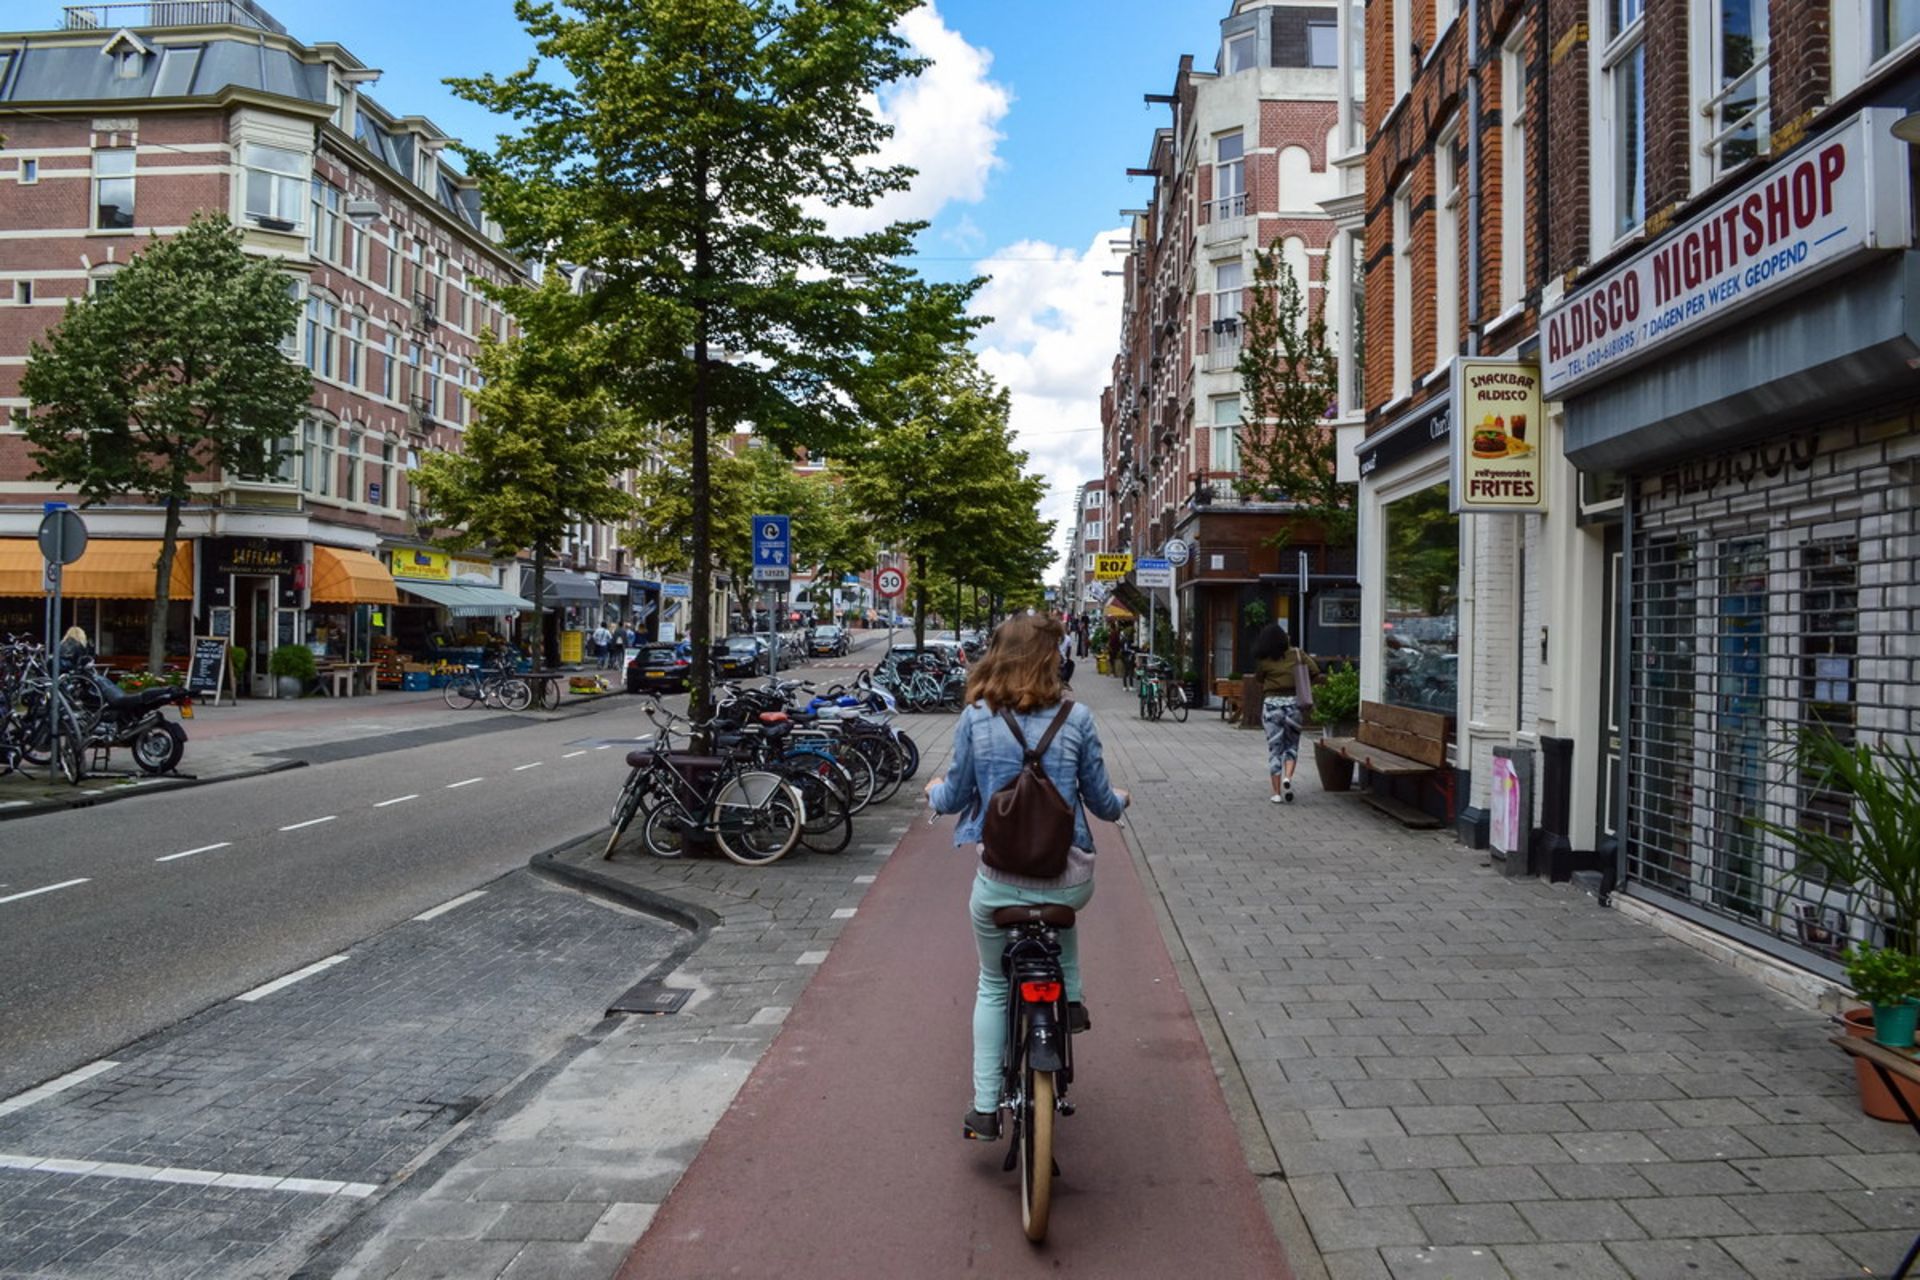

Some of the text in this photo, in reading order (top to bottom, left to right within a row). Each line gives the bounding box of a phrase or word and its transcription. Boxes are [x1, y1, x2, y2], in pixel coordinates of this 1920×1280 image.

[1548, 143, 1845, 364] ALDISCO NIGHTSHOP
[1568, 357, 1585, 376] TEL:
[1650, 303, 1684, 337] DAGEN
[1685, 294, 1706, 318] PER
[1708, 274, 1742, 305] WEEK
[1745, 241, 1808, 288] GEOPEND
[1470, 373, 1535, 390] SNACKBAR
[1477, 390, 1528, 401] ALDISCO
[1470, 480, 1535, 498] FRITES
[881, 576, 900, 588] 30
